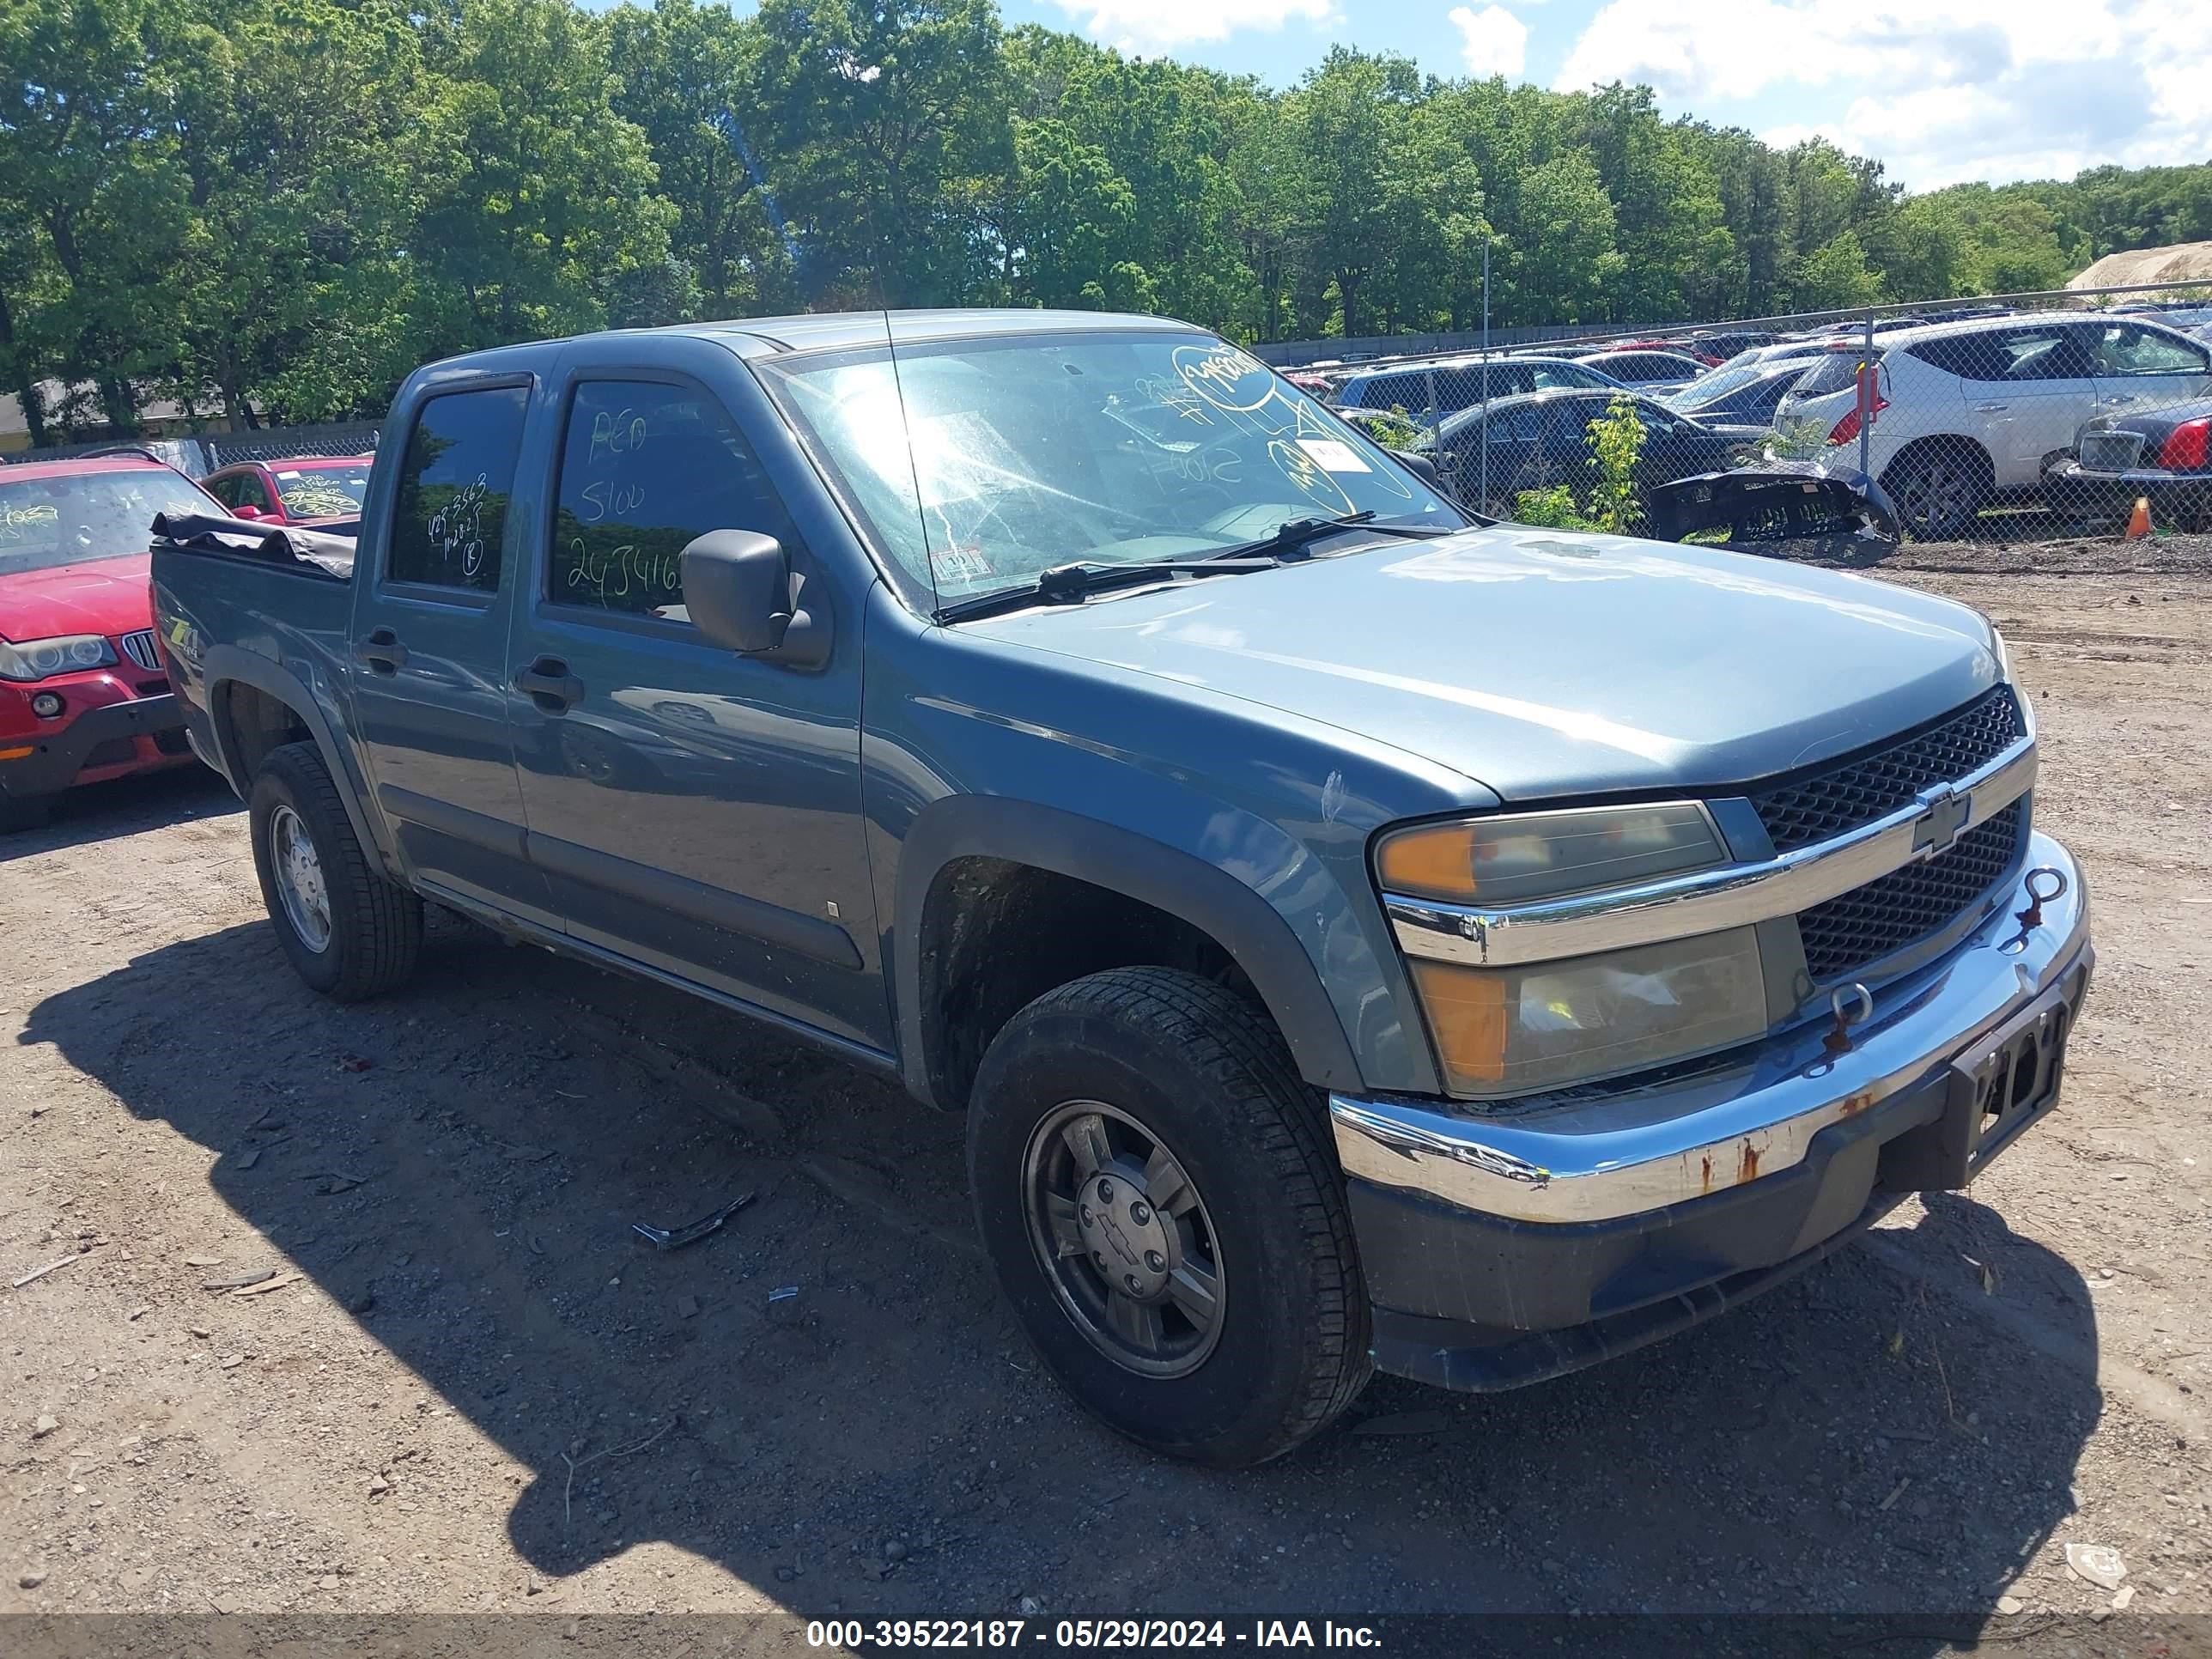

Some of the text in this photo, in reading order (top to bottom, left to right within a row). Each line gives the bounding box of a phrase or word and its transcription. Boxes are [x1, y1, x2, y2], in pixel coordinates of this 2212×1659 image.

[453, 472, 487, 520] 3563
[582, 480, 646, 521] S100
[568, 537, 684, 610] 24J416
